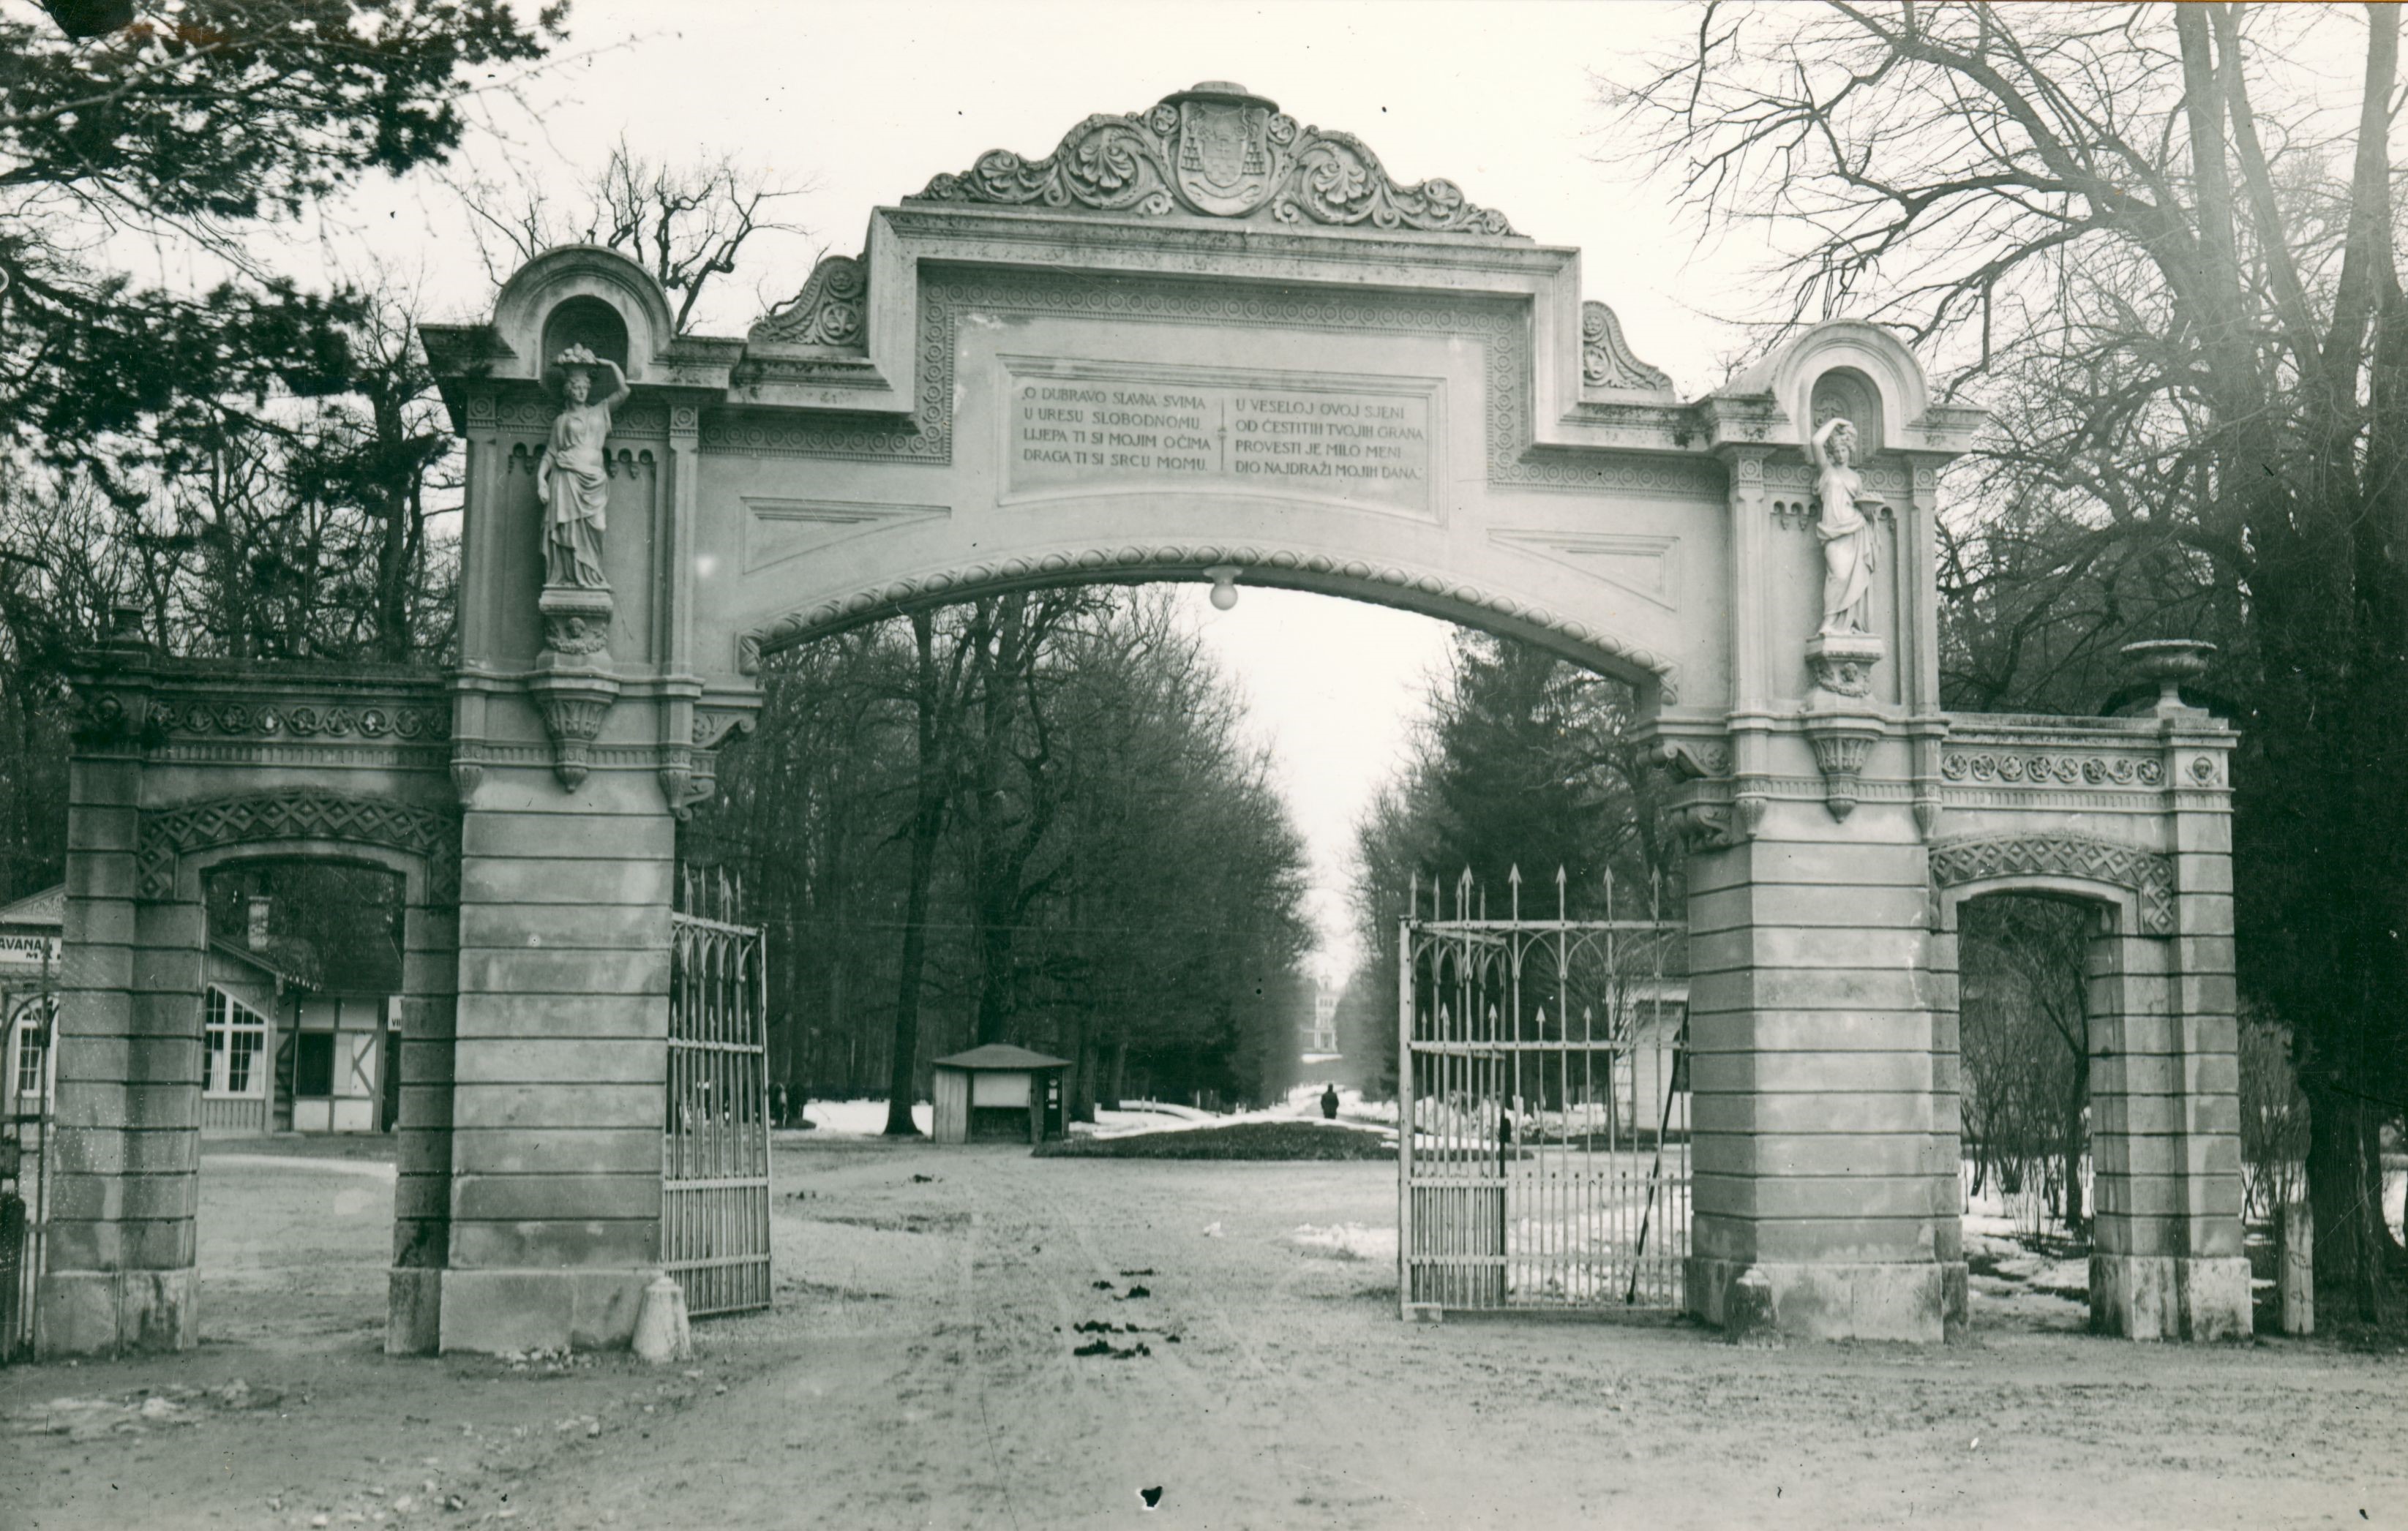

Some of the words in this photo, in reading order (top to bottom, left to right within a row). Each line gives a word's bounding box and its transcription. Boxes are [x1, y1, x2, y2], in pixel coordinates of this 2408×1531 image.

[1041, 387, 1107, 403] DUBRAVO
[1112, 391, 1157, 407] SLAVNA
[1163, 395, 1206, 410] SVIMA
[1024, 407, 1033, 420] U
[1038, 407, 1084, 423] URESU
[1236, 399, 1245, 412] U
[1250, 399, 1314, 415] VESELOJ
[1320, 403, 1359, 417] OVOJ
[1365, 405, 1404, 419] SJENI
[1024, 427, 1068, 443] LIJEPA
[1073, 430, 1085, 443] TI
[1091, 432, 1103, 445] SI
[1109, 433, 1157, 448] MOJIM
[1163, 435, 1211, 451] OČIMA
[1236, 420, 1258, 432] OD
[1326, 424, 1373, 438] TVOJIH
[1377, 426, 1424, 440] GRANA
[1024, 448, 1070, 464] DRAGA
[1073, 451, 1087, 464] TI
[1092, 452, 1103, 465] SI
[1110, 454, 1150, 467] SRCU
[1235, 440, 1301, 455] PROVESTI
[1305, 443, 1321, 455] JE
[1326, 443, 1361, 457] MILO
[1366, 445, 1401, 459] MENI
[1235, 460, 1260, 473] DIO
[1264, 460, 1331, 476] NAJDRAŽI
[1335, 464, 1378, 478] MOJIH
